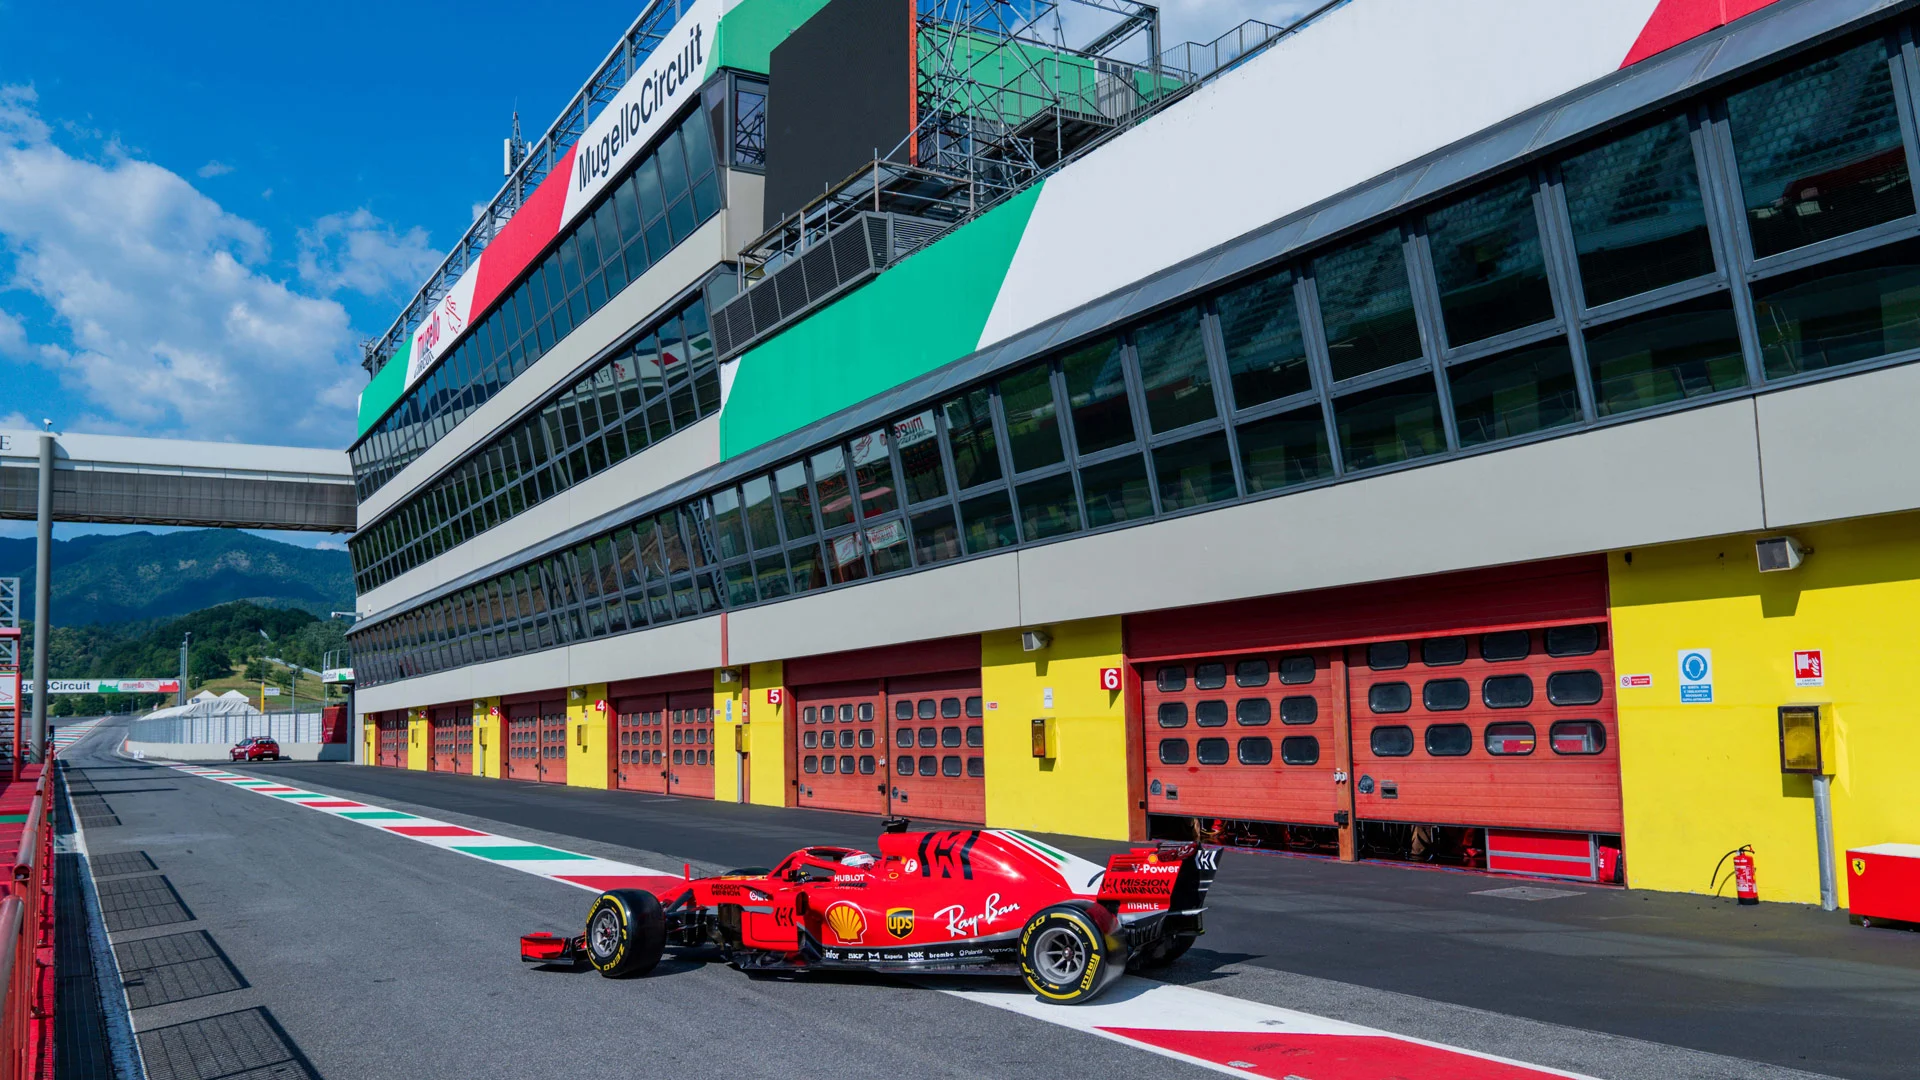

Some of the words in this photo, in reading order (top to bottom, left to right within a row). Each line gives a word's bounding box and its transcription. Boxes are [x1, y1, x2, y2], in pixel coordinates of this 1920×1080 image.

[579, 23, 703, 192] MugelloCircuit
[1104, 668, 1118, 688] 6
[770, 689, 780, 703] 5
[491, 706, 499, 715] 3
[596, 700, 605, 711] 4
[420, 710, 426, 718] 2
[1132, 863, 1180, 874] V-Power
[834, 873, 865, 882] HUBLOT
[1120, 878, 1170, 887] MISSION
[1120, 886, 1171, 895] WINNOW
[1127, 902, 1159, 910] MAHLE
[888, 916, 913, 935] ups
[1020, 915, 1046, 957] ZERO
[603, 943, 625, 971] ZERO
[929, 951, 955, 959] brembo
